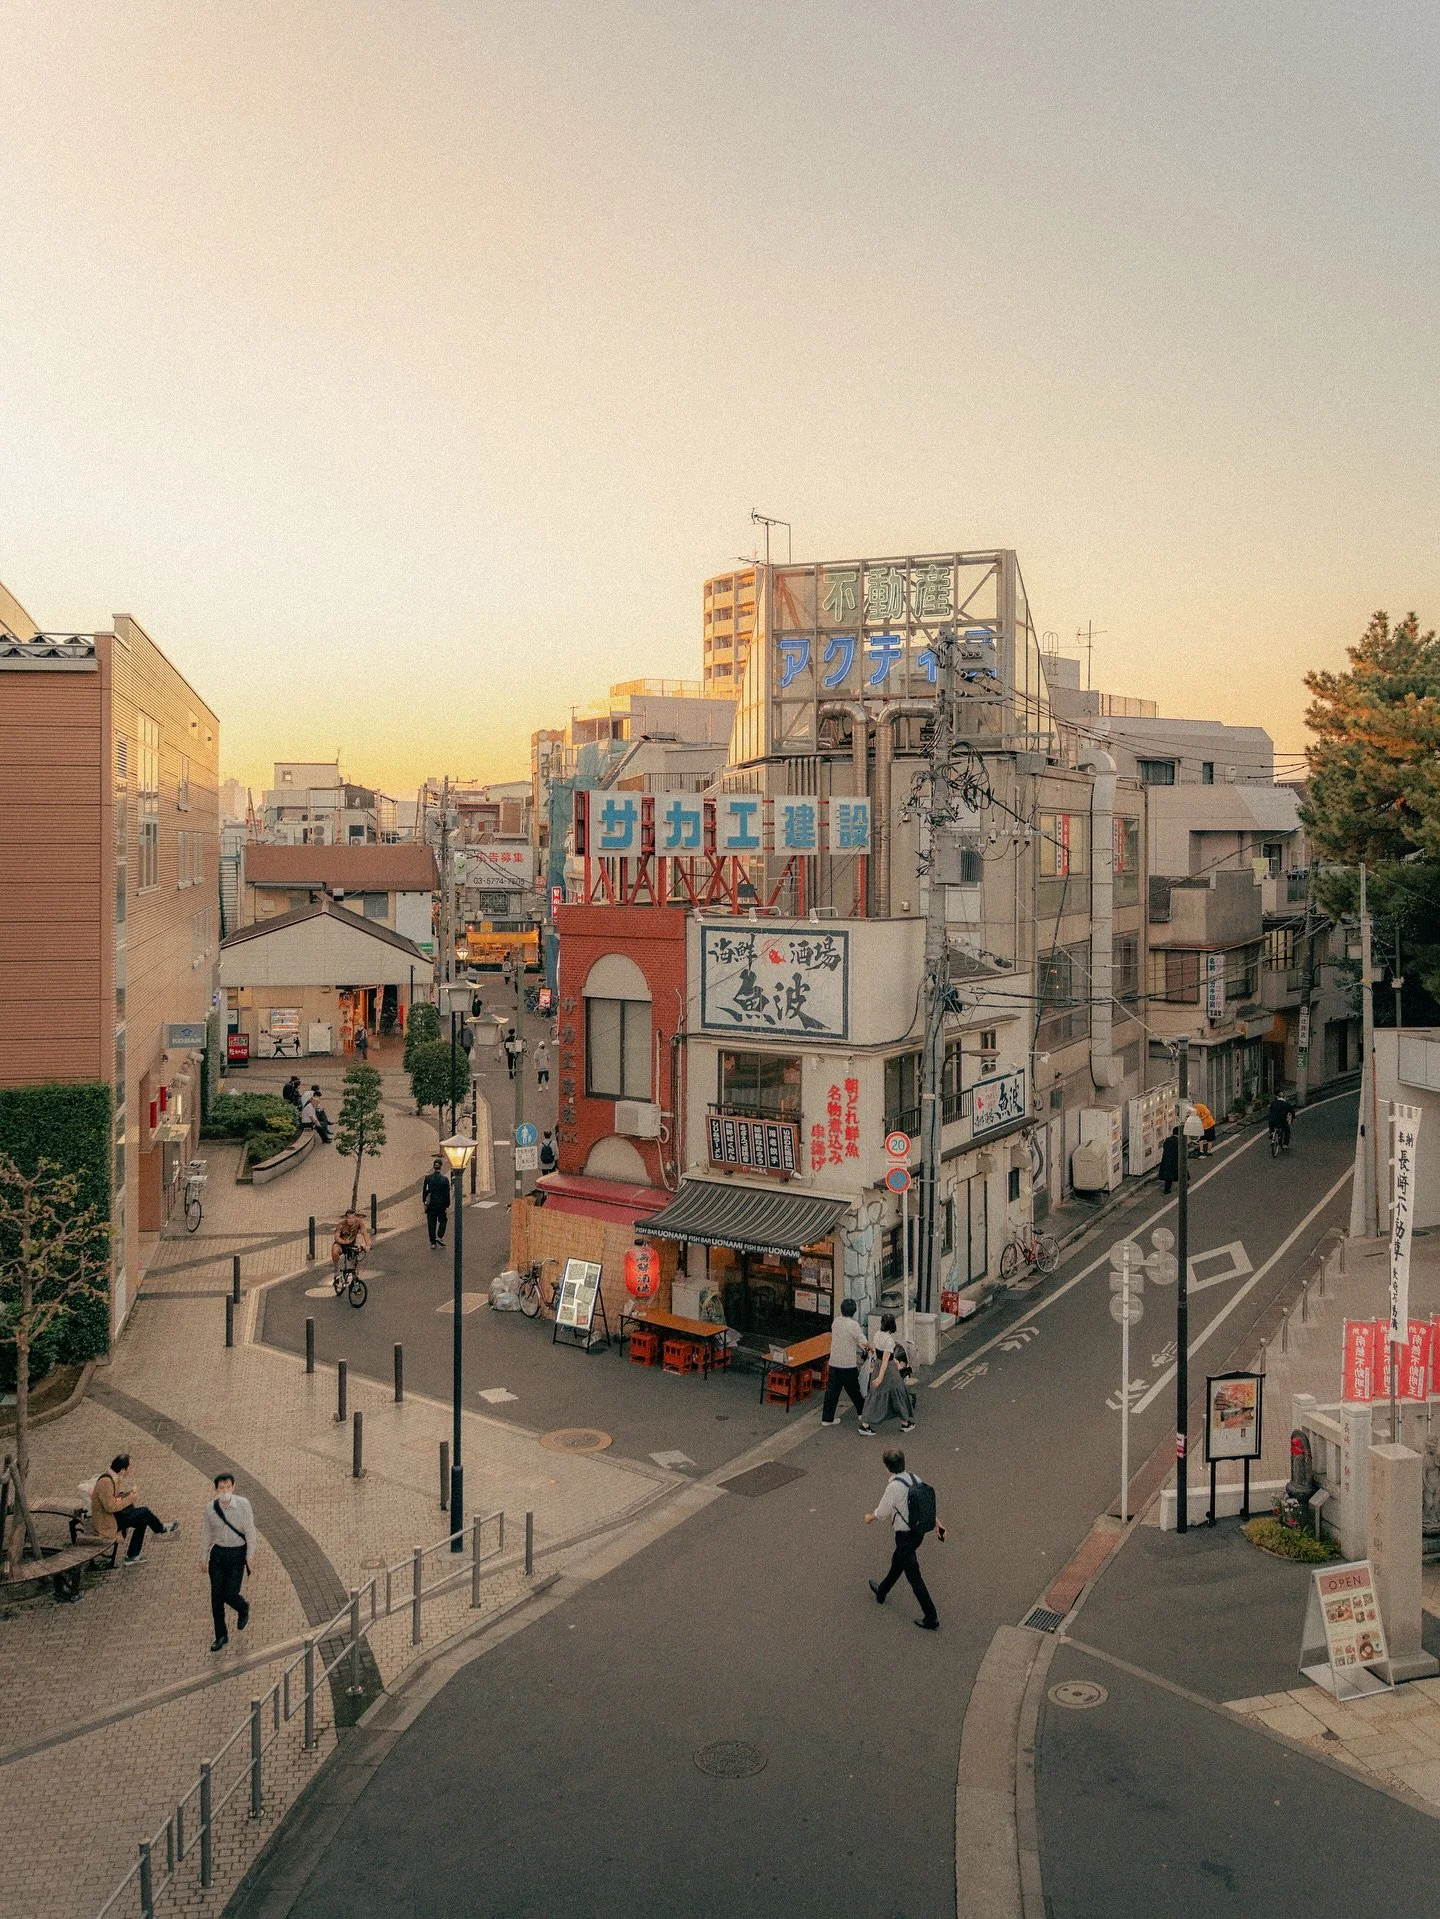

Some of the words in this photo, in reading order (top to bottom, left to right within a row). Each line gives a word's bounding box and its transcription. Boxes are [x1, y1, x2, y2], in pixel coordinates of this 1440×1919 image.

[822, 564, 951, 622] 不動産
[598, 799, 870, 849] サカエ建設
[708, 933, 758, 970] 海鮮
[789, 934, 842, 971] 酒場
[715, 968, 831, 1030] 魚波
[827, 1084, 843, 1165] 名物煮込み
[844, 1078, 860, 1158] 朝とれ鮮魚
[891, 1139, 905, 1151] 20
[657, 1230, 688, 1240] UONAMI
[688, 1235, 700, 1243] FISH
[711, 1239, 744, 1249] UONAMI
[744, 1243, 756, 1251] FISH
[768, 1246, 801, 1258] UONAMI
[1328, 1575, 1361, 1590] OPEN
